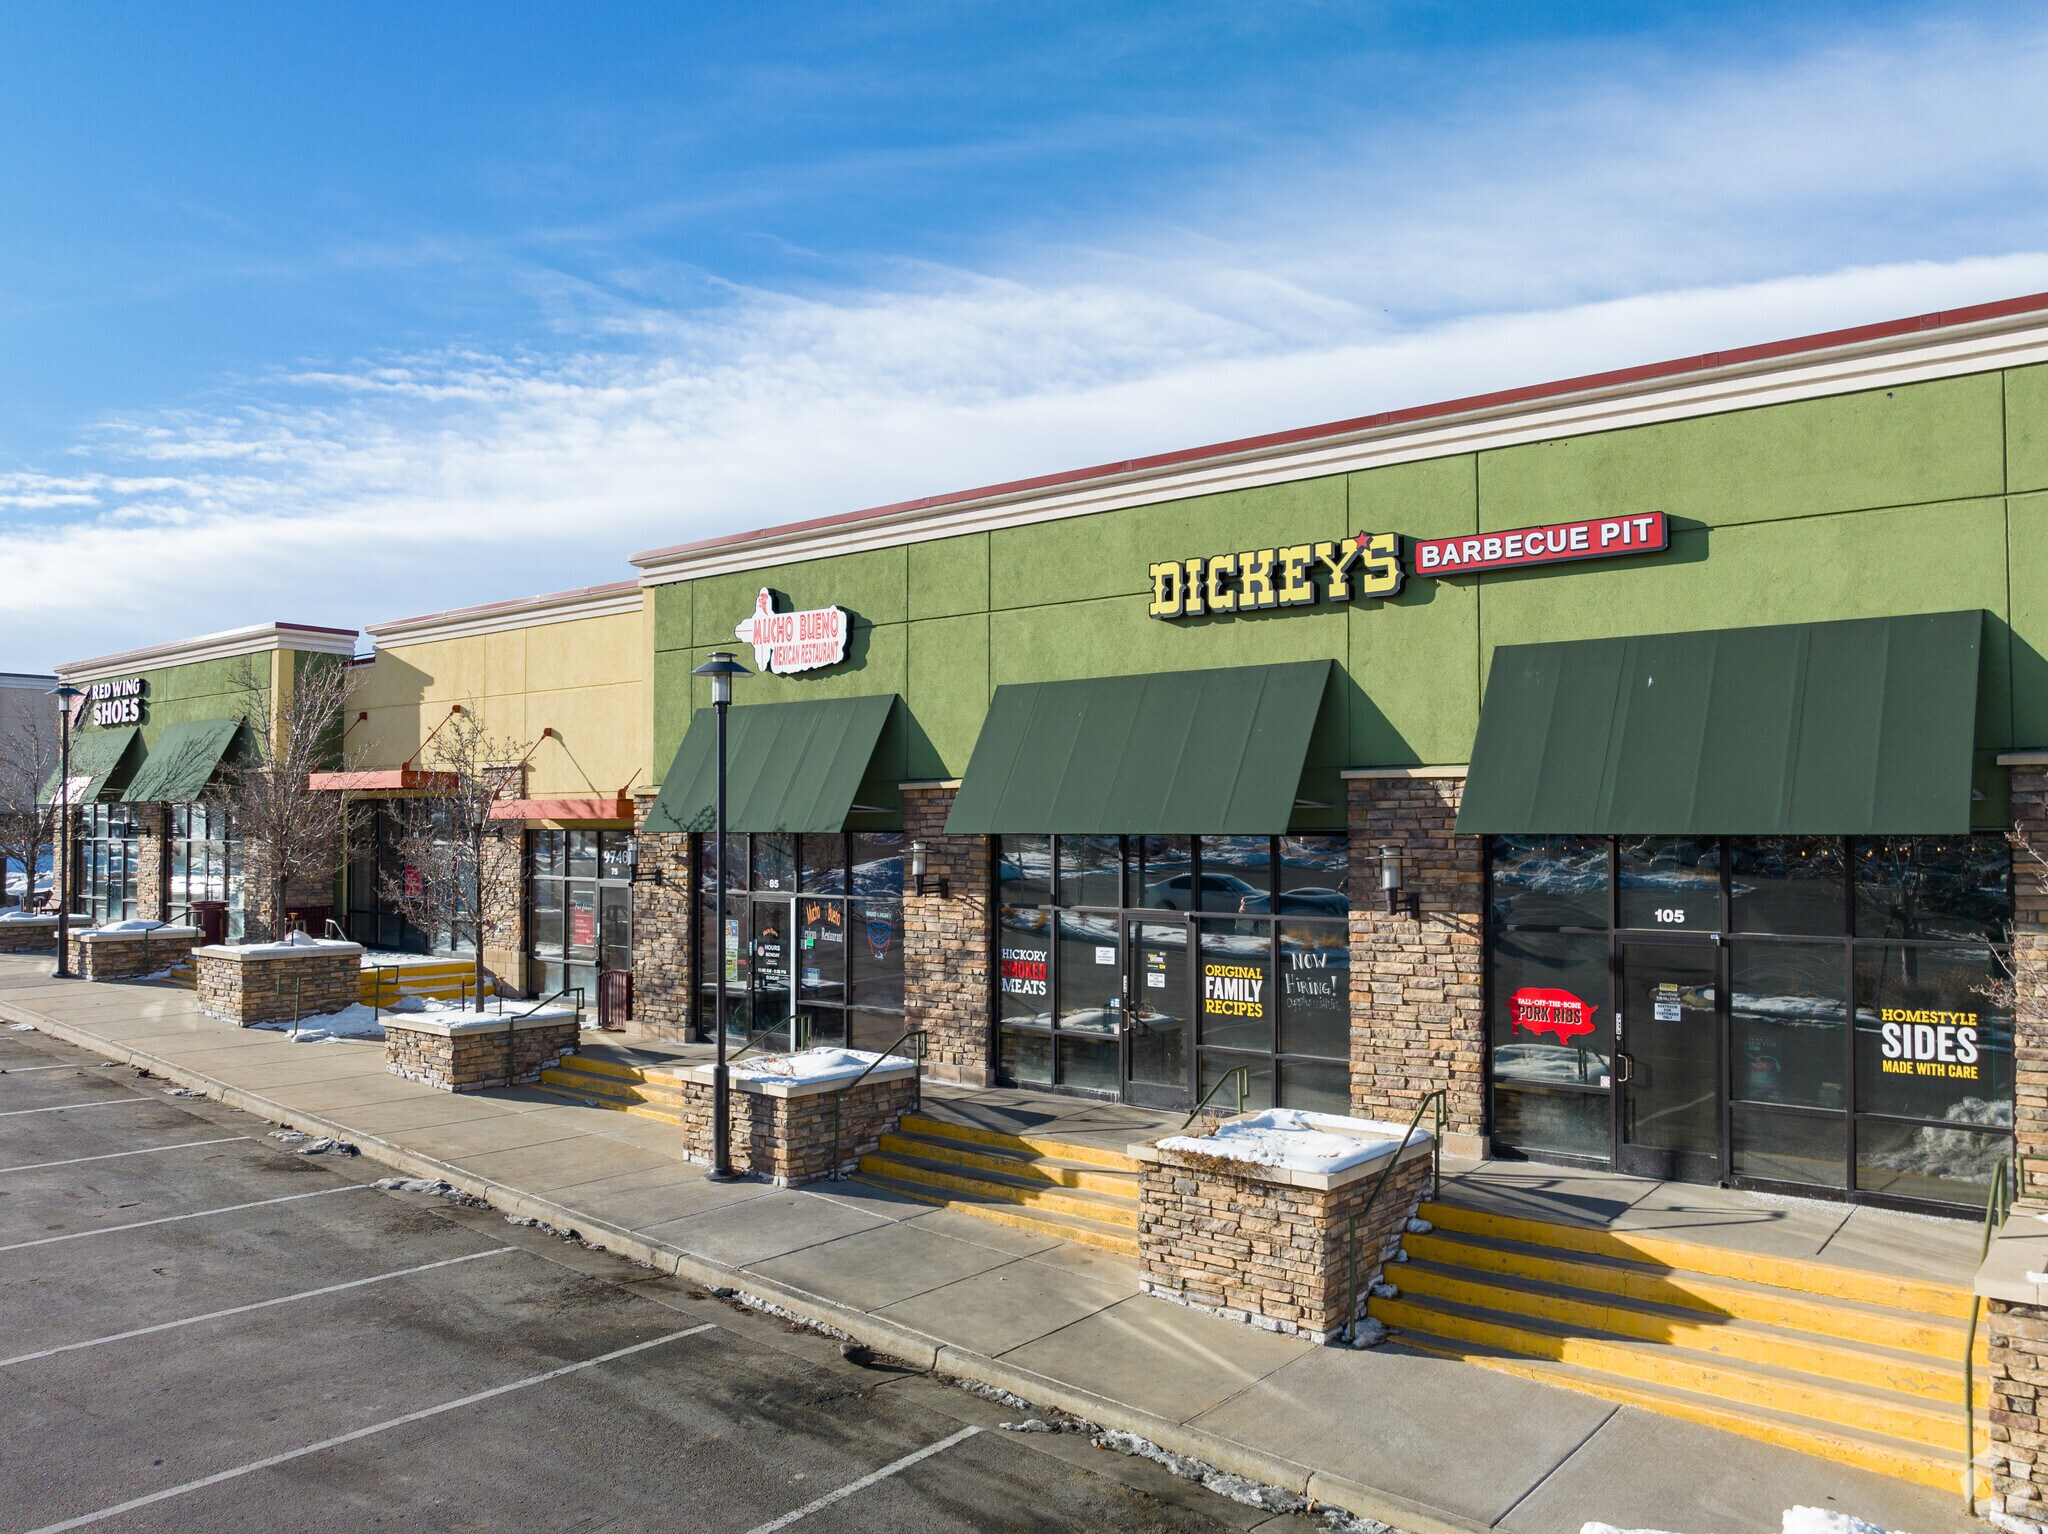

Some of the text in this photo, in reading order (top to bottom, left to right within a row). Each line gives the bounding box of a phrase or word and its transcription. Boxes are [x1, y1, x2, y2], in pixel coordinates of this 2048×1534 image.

[1422, 517, 1654, 568] BARBECUE PIT
[753, 611, 838, 645] MUCHO BUENO
[774, 641, 838, 665] MEXICAN RESTAURANT
[92, 677, 140, 700] RED WING
[93, 697, 140, 726] SHOES
[611, 867, 619, 876] 75
[769, 879, 779, 888] 85
[1654, 908, 1685, 923] 105
[764, 944, 781, 952] HOURS
[1001, 949, 1048, 962] HICKORY
[1001, 960, 1048, 980] SMOKED
[1291, 952, 1328, 971] NOW
[1205, 964, 1263, 980] ORIGINAL
[1001, 978, 1047, 996] MEATS
[1205, 976, 1263, 1003] FAMILY
[1205, 999, 1263, 1018] RECIPES
[1518, 998, 1582, 1009] FALL-OFF-THE-BONE
[1518, 1005, 1582, 1026] PORK RIBS
[1881, 1009, 1977, 1026] HOMESTYLE
[1881, 1022, 1978, 1063] SIDES
[1882, 1060, 1979, 1080] MADE WITH CARE
